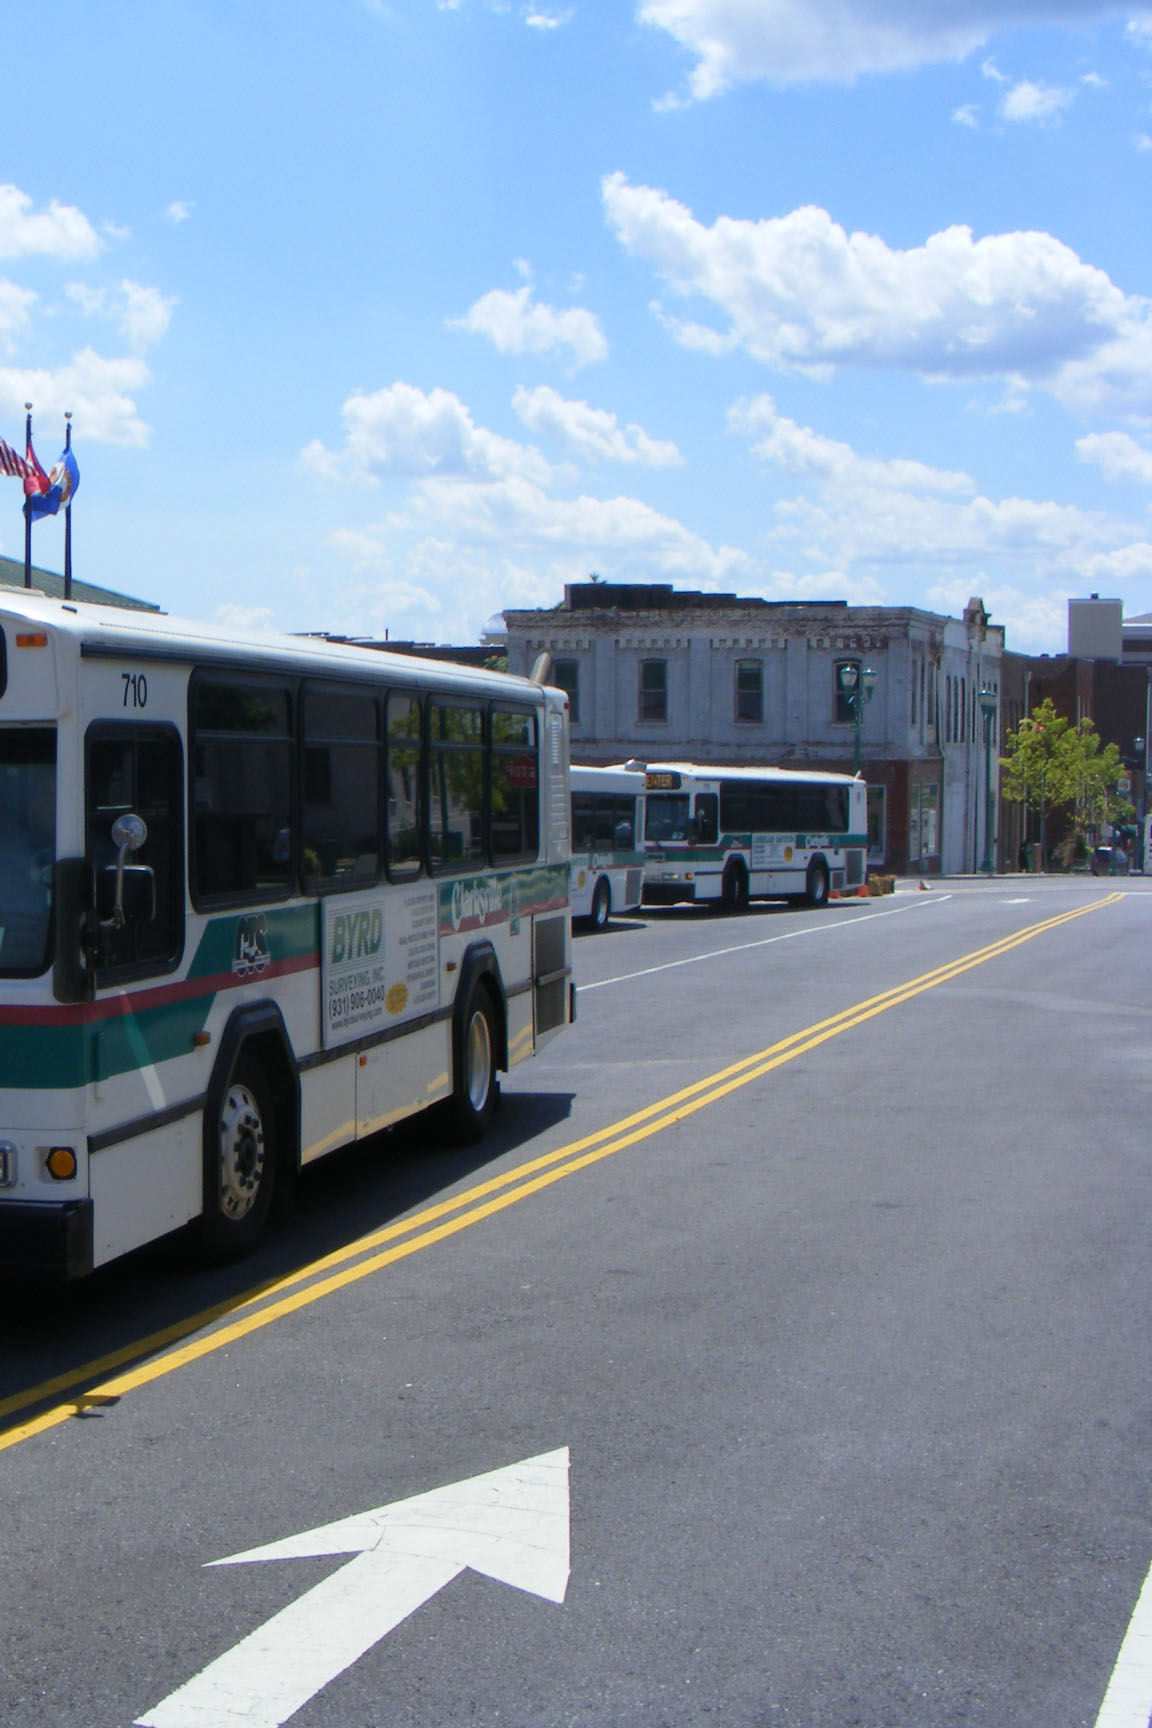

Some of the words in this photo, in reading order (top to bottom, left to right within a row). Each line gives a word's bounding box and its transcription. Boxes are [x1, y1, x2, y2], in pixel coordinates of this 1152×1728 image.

[121, 673, 147, 708] 710
[332, 909, 384, 964] BYRD
[328, 994, 349, 1020] (931)
